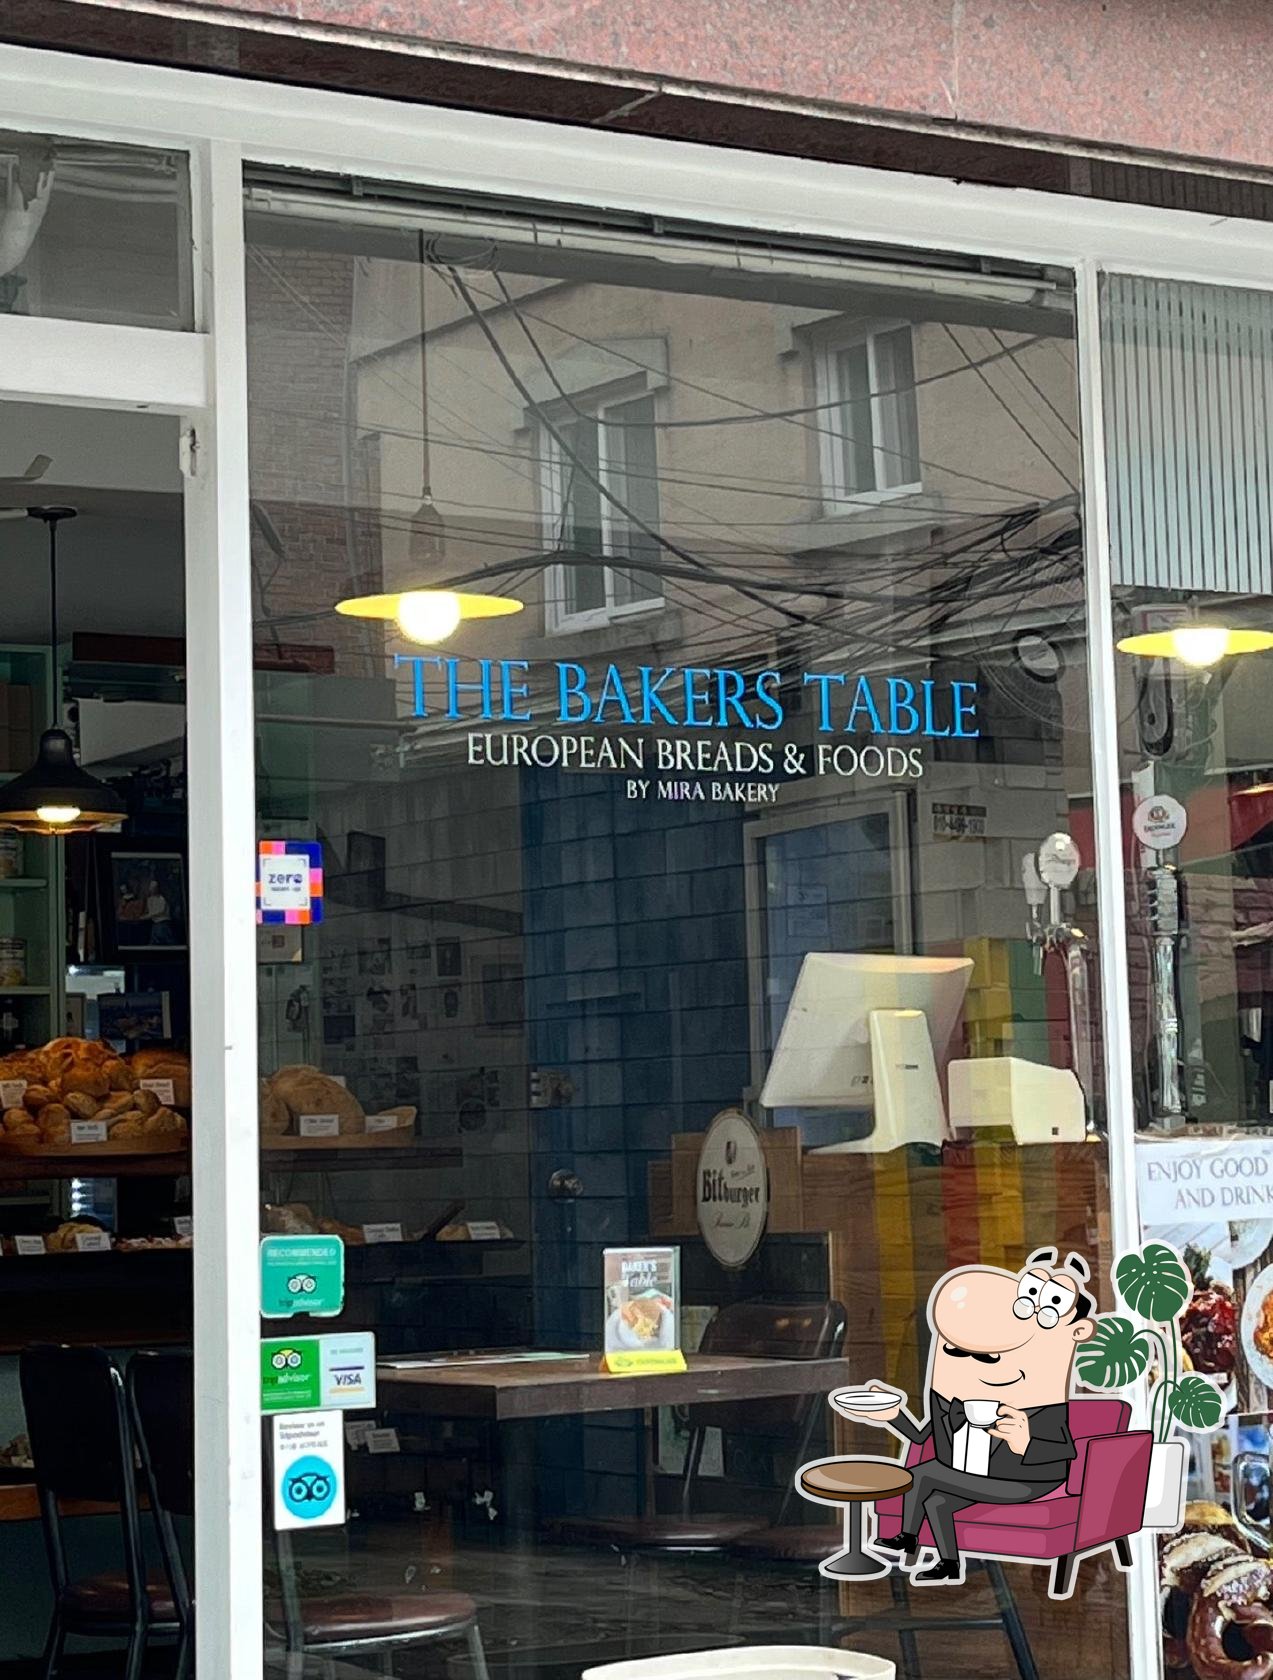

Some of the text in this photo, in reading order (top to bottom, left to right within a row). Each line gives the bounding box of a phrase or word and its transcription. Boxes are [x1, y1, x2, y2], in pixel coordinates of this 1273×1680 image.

[393, 652, 980, 739] THE BAKERS TABLE
[467, 732, 924, 778] EUROPEAN BREADS & FOODS
[626, 779, 780, 803] BY MIRA BAKERY
[1147, 1157, 1268, 1183] ENJOY GOOD
[702, 1169, 760, 1208] Bitburger
[1175, 1187, 1215, 1209] AND
[335, 1373, 362, 1386] VISA
